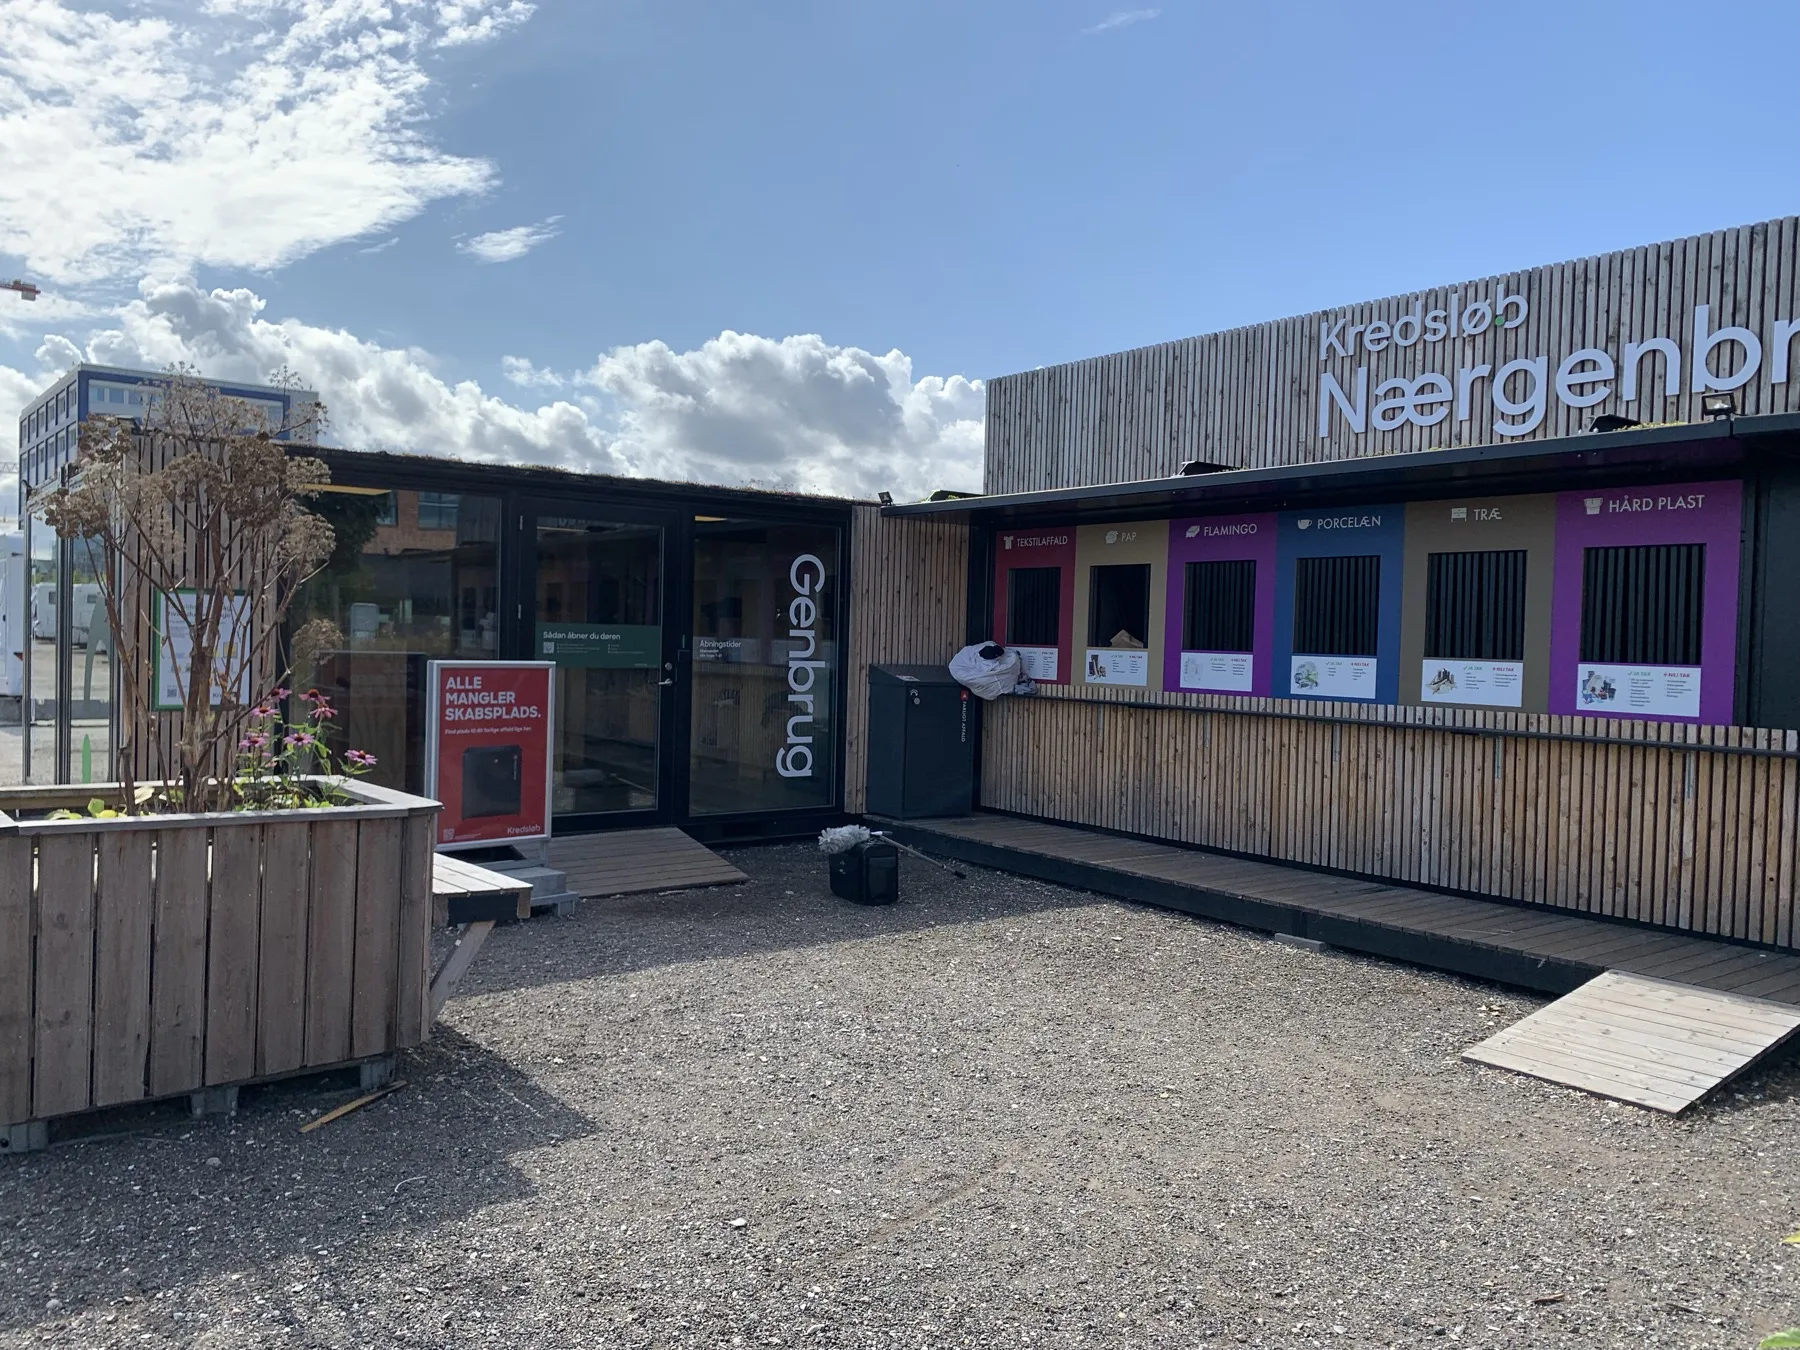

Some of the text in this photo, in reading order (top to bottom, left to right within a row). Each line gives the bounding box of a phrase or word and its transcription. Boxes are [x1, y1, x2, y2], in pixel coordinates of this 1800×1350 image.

[1320, 284, 1529, 361] Kredsløb
[1608, 495, 1706, 513] HÅRD PLAST
[1473, 508, 1503, 521] TRÆ
[1317, 516, 1381, 530] PORCELÆN
[1121, 532, 1137, 542] PAP
[1203, 524, 1258, 537] FLAMINGO
[1016, 535, 1068, 548] TEKSTILAFFALD
[543, 631, 621, 641] Sådan åbner du døren
[775, 553, 826, 778] Genbrug
[445, 676, 482, 690] ALLE
[445, 691, 516, 706] MANGLER
[445, 705, 542, 721] SKABSPLADS.
[507, 824, 541, 835] Kredsløb
